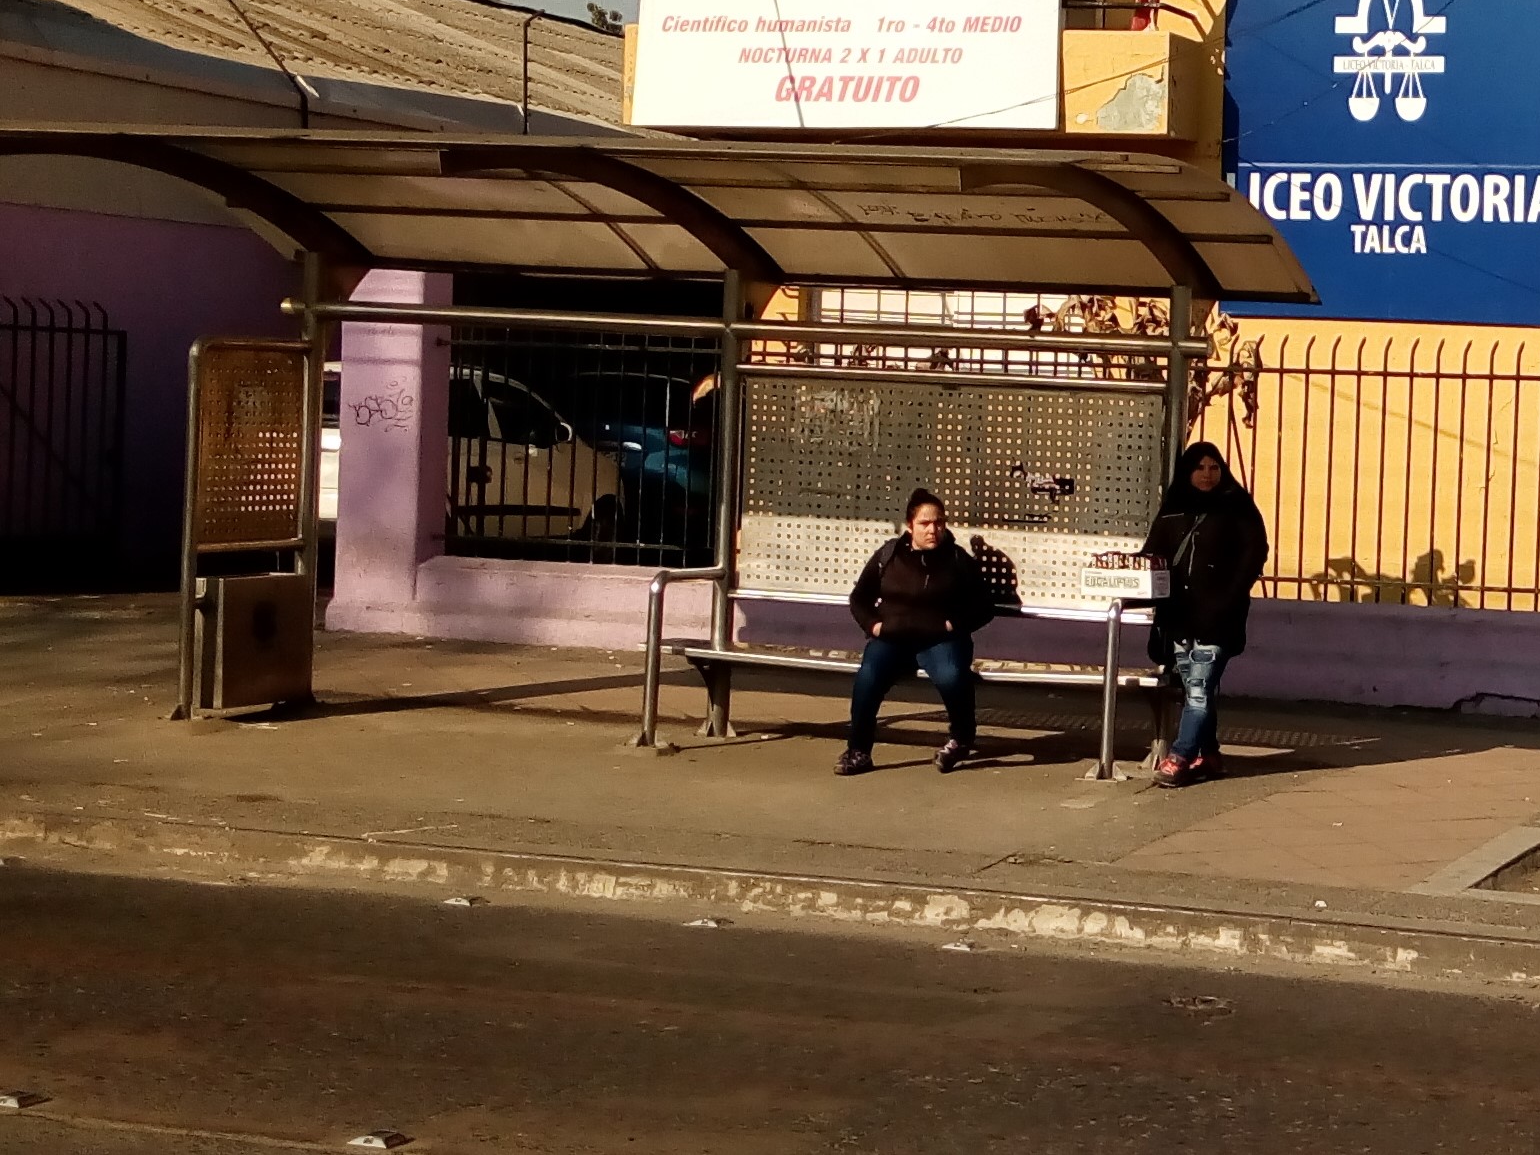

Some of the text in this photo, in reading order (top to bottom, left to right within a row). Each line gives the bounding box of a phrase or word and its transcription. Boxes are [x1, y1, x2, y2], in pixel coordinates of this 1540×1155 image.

[661, 15, 749, 33] Científico
[754, 15, 851, 33] humanista
[876, 16, 905, 33] 1ro
[925, 16, 956, 33] 4to
[962, 16, 1023, 33] MEDIO
[738, 47, 963, 64] NOCTURNA 2 X 1 ADULTO
[775, 75, 921, 103] GRATUITO
[1227, 172, 1344, 221] ICEO
[1350, 225, 1428, 254] TALCA
